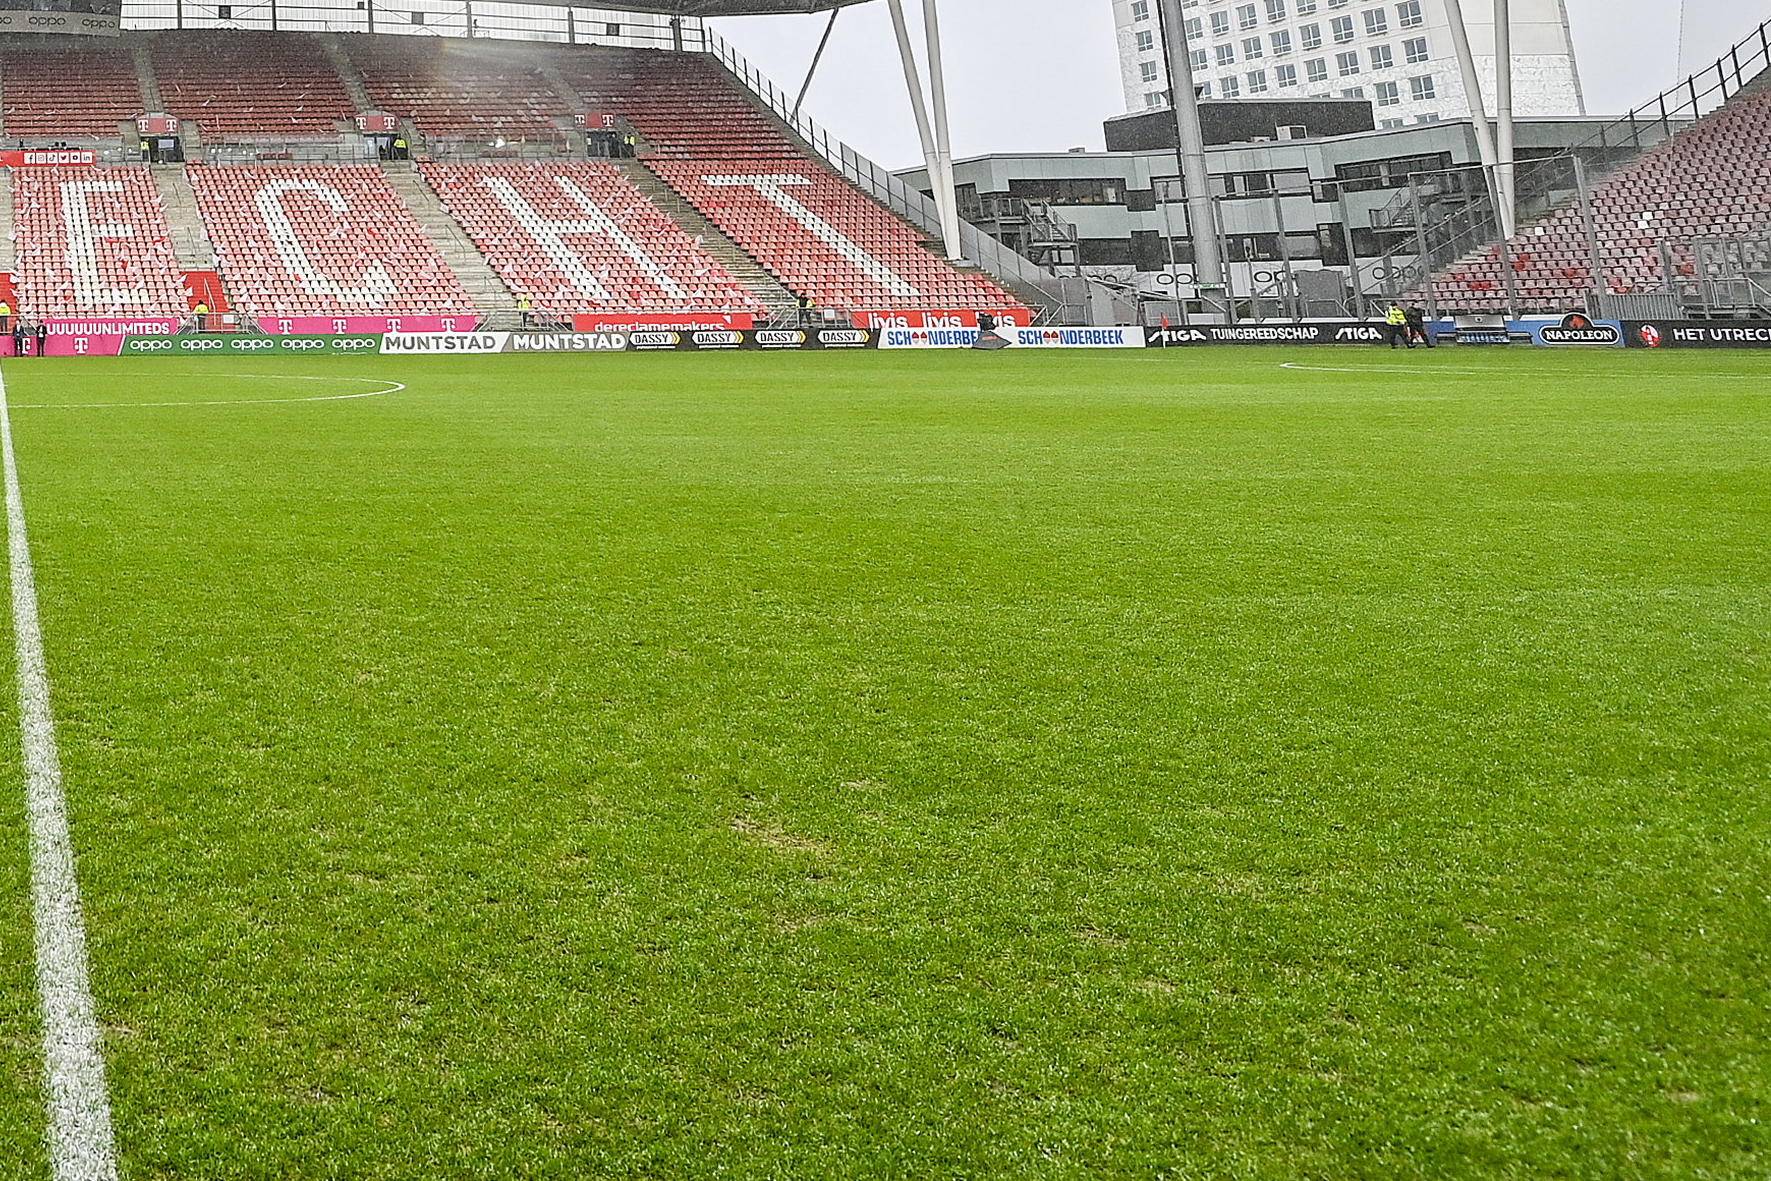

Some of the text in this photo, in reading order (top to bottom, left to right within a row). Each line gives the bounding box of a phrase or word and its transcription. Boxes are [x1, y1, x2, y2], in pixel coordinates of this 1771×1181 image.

[29, 17, 66, 27] oppo
[82, 19, 115, 29] oppo
[594, 321, 725, 332] dereclamemakers
[635, 334, 669, 344] DASSY
[697, 333, 731, 343] DASSY
[760, 332, 794, 342] DASSY
[822, 332, 857, 342] DASSY
[1148, 327, 1383, 343] STIGA TUINGEREEDSCHAP STIGA
[1544, 330, 1613, 341] NAPOLEON
[1673, 328, 1706, 341] HET
[129, 338, 173, 352] oppo
[180, 338, 224, 352] oppo
[230, 338, 274, 351] oppo
[281, 338, 325, 351] oppo
[331, 337, 375, 351] oppo
[385, 335, 496, 351] MUNTSTAD
[513, 333, 626, 350] MUNTSTAD
